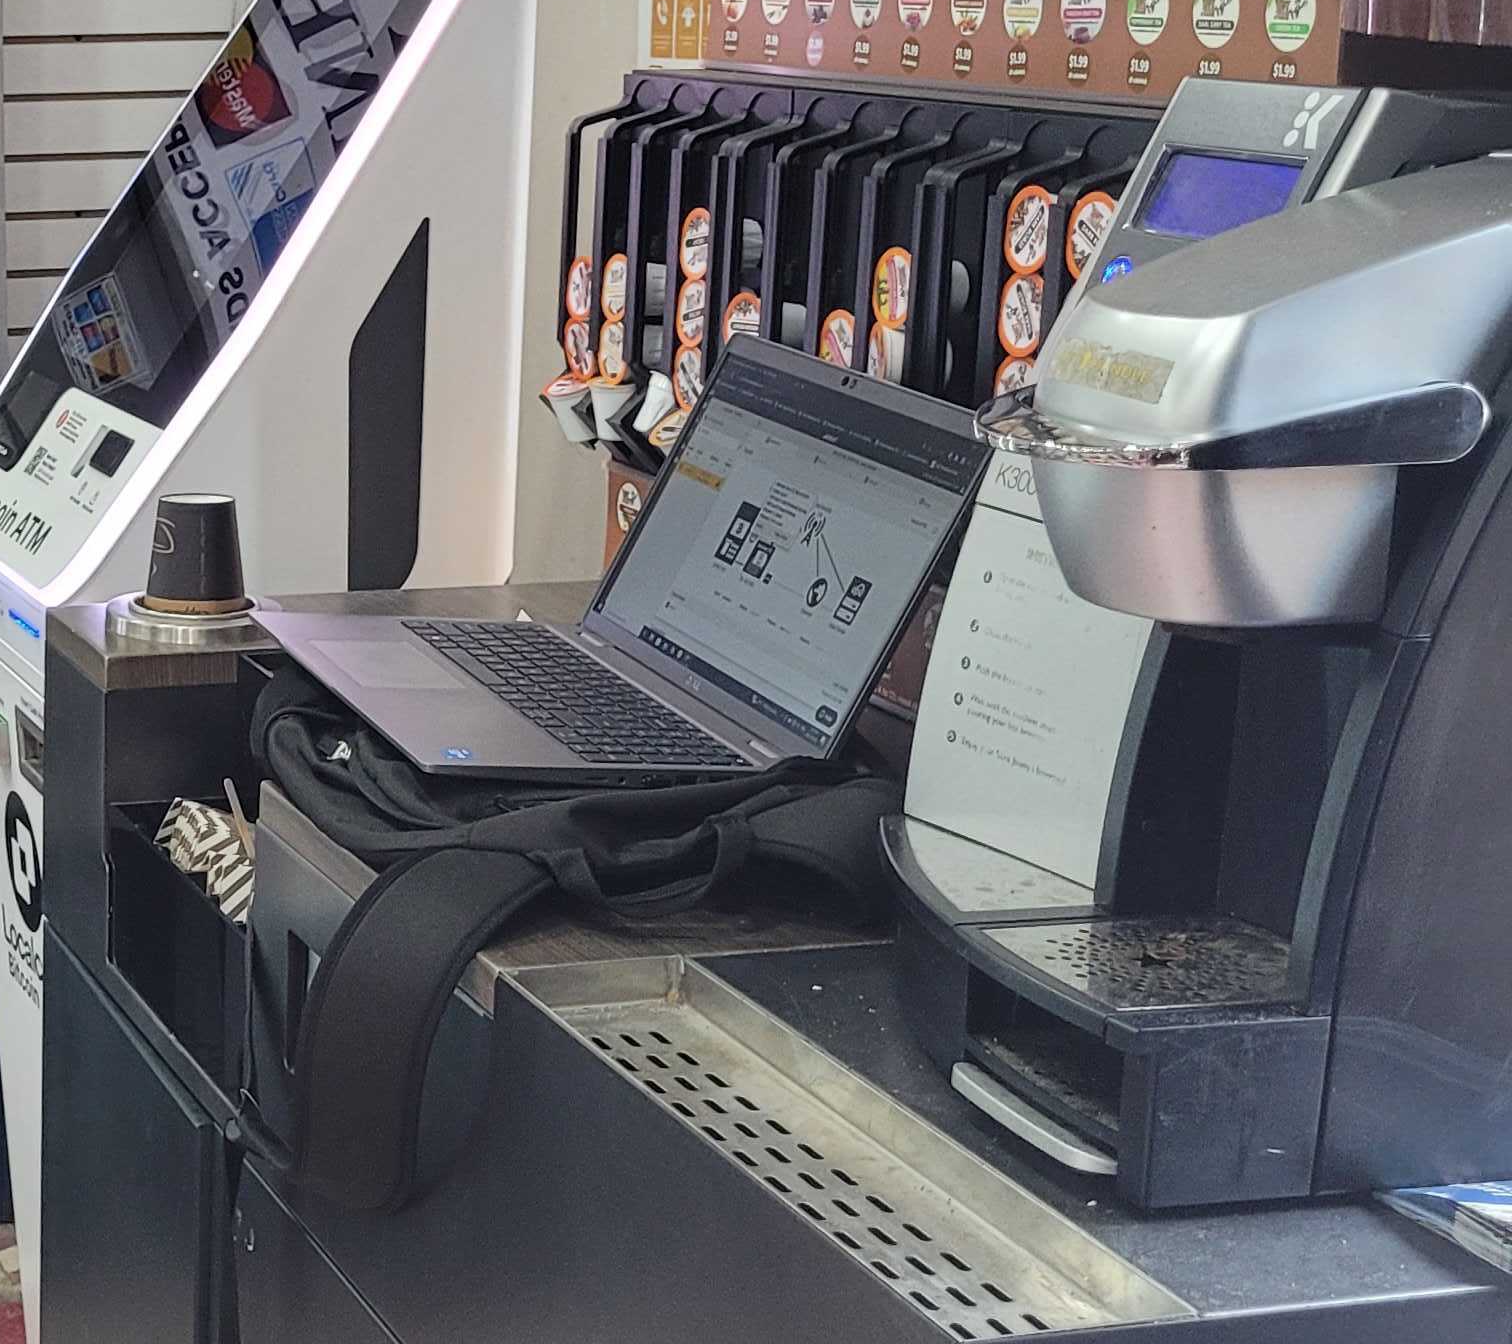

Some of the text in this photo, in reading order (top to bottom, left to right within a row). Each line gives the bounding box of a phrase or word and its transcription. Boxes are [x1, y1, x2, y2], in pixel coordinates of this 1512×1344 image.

[955, 48, 972, 61] $1.99
[1008, 51, 1026, 66] $1.99
[1069, 54, 1088, 68] $1.99
[1130, 59, 1149, 73] $1.99
[1199, 58, 1221, 74] $1.99
[1272, 63, 1295, 78] $1.99
[10, 512, 52, 556] ATM
